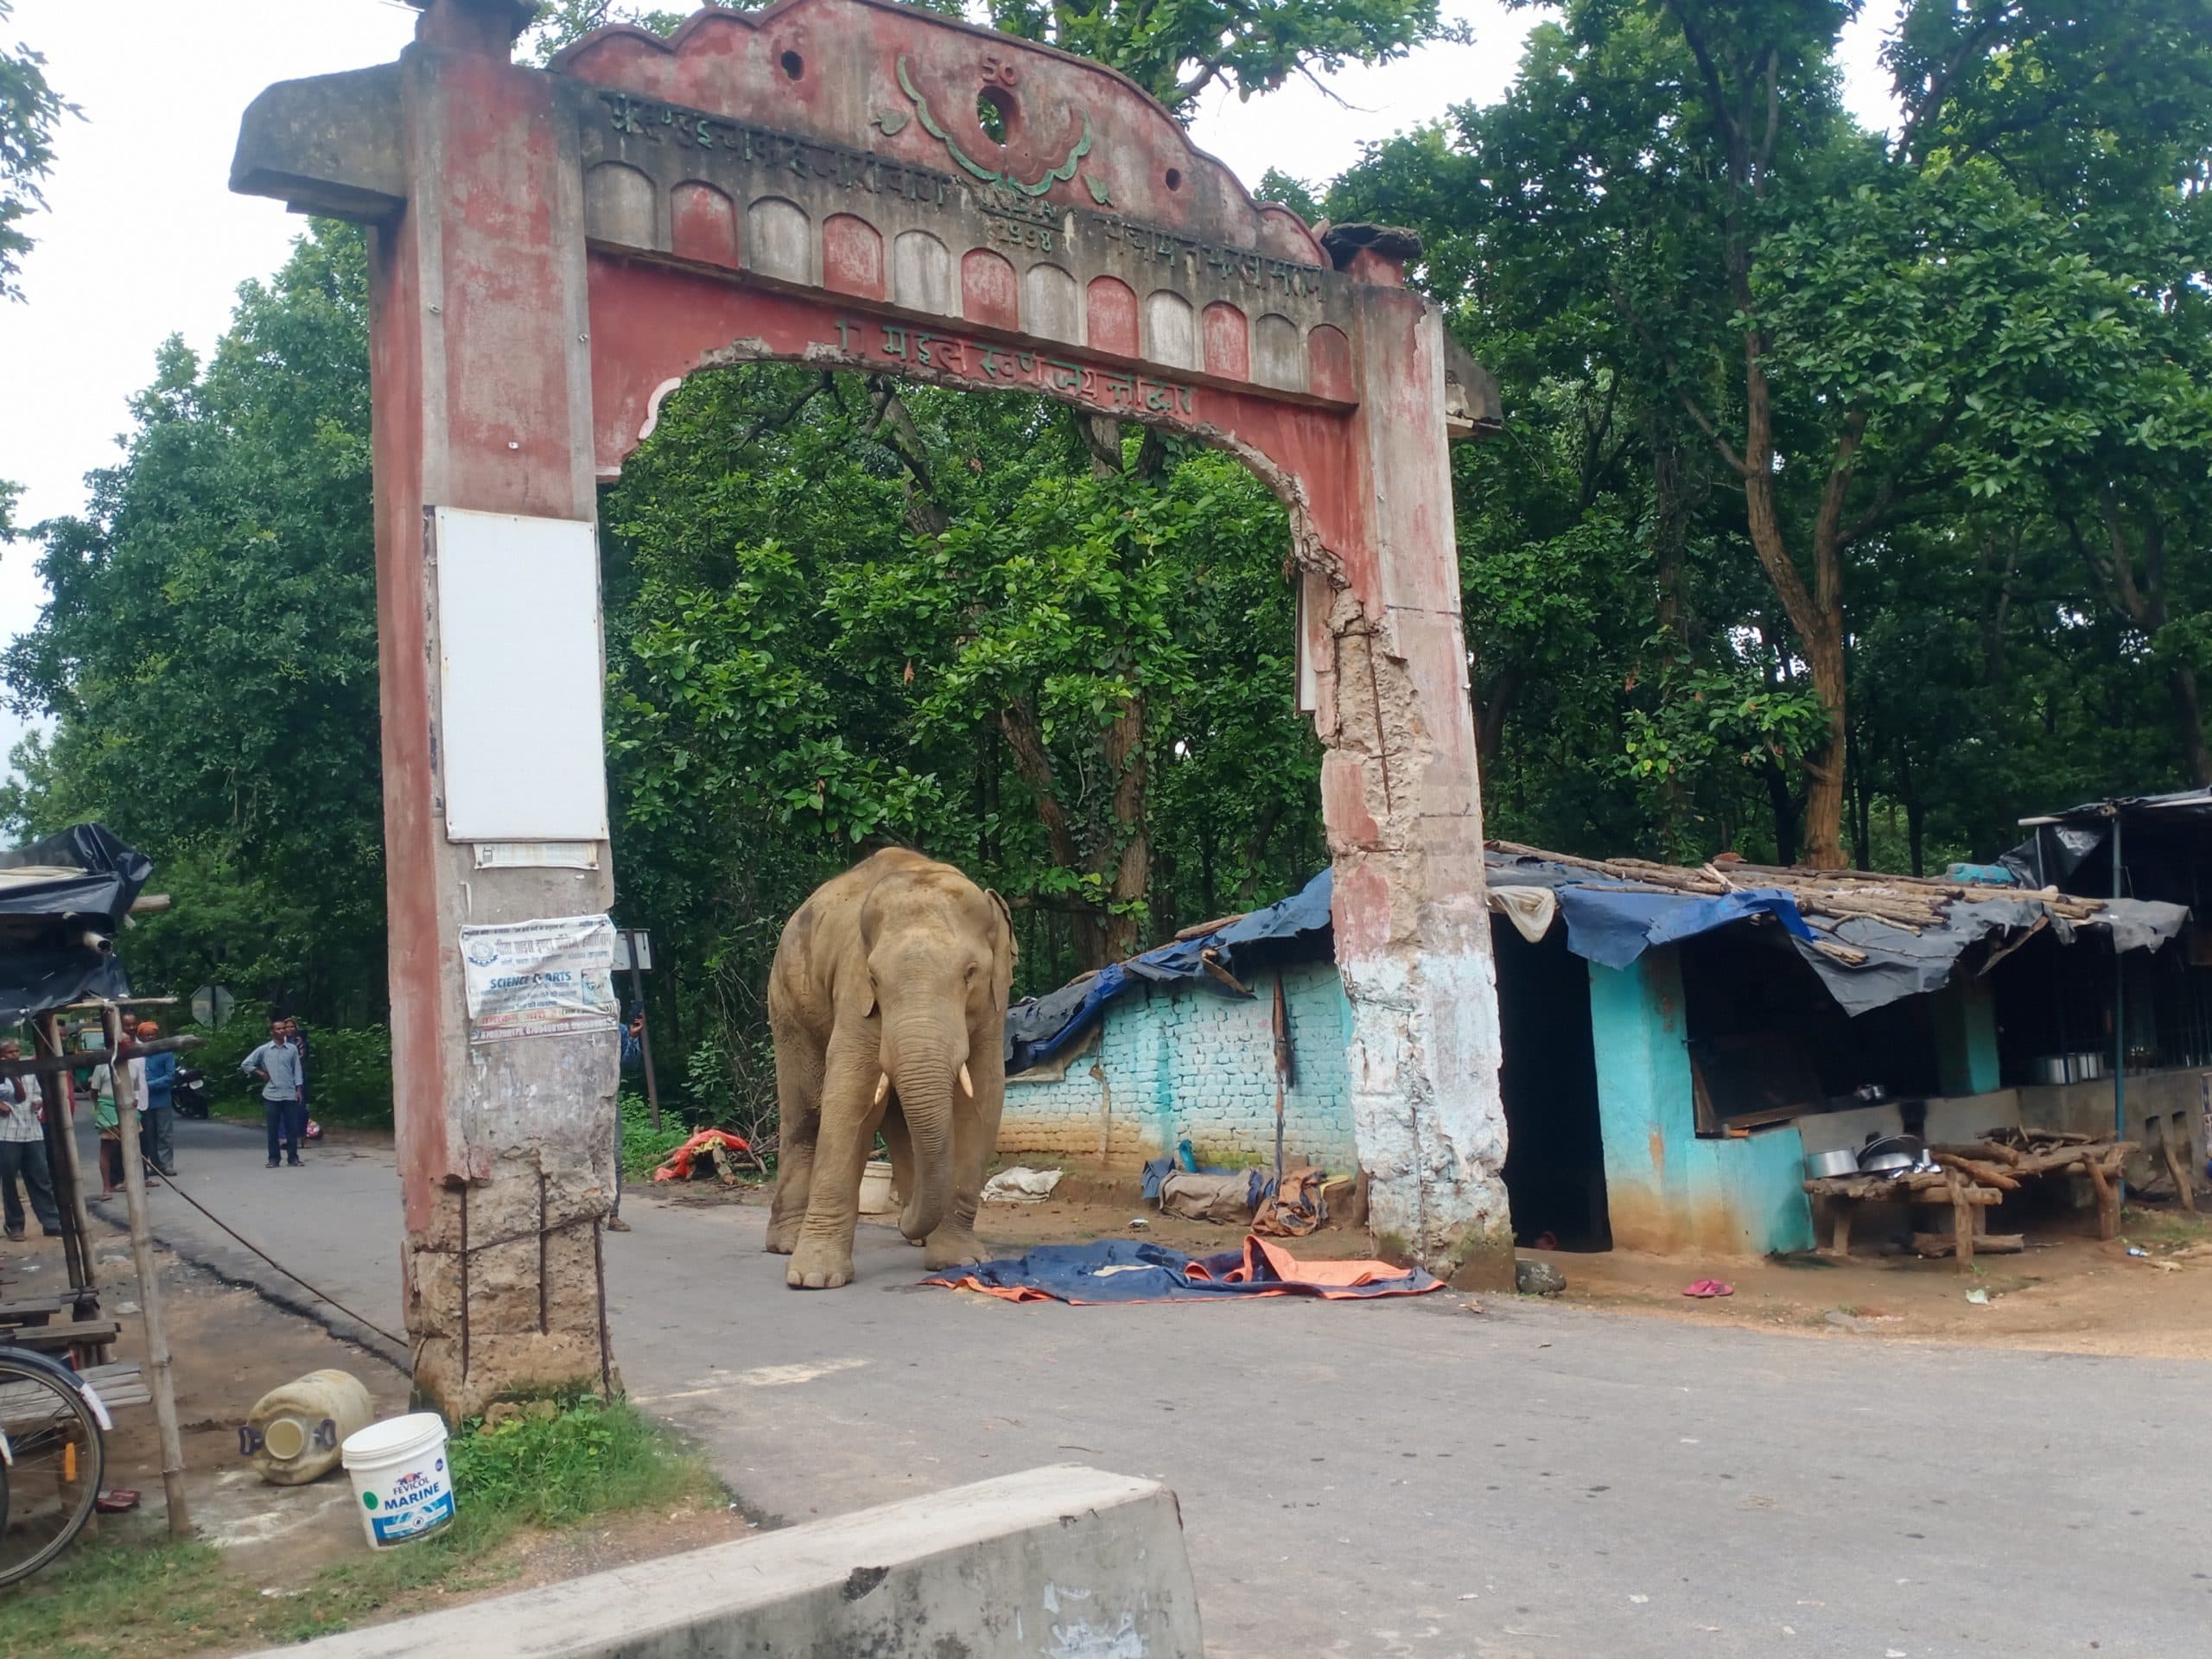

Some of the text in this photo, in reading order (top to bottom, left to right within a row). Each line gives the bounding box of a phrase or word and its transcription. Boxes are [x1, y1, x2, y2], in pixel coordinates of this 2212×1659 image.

[981, 55, 1017, 86] 50
[490, 974, 530, 988] SCIENCE
[545, 971, 571, 983] ARTS
[385, 1482, 440, 1510] MARINE
[393, 1477, 429, 1495] FEVICOL
